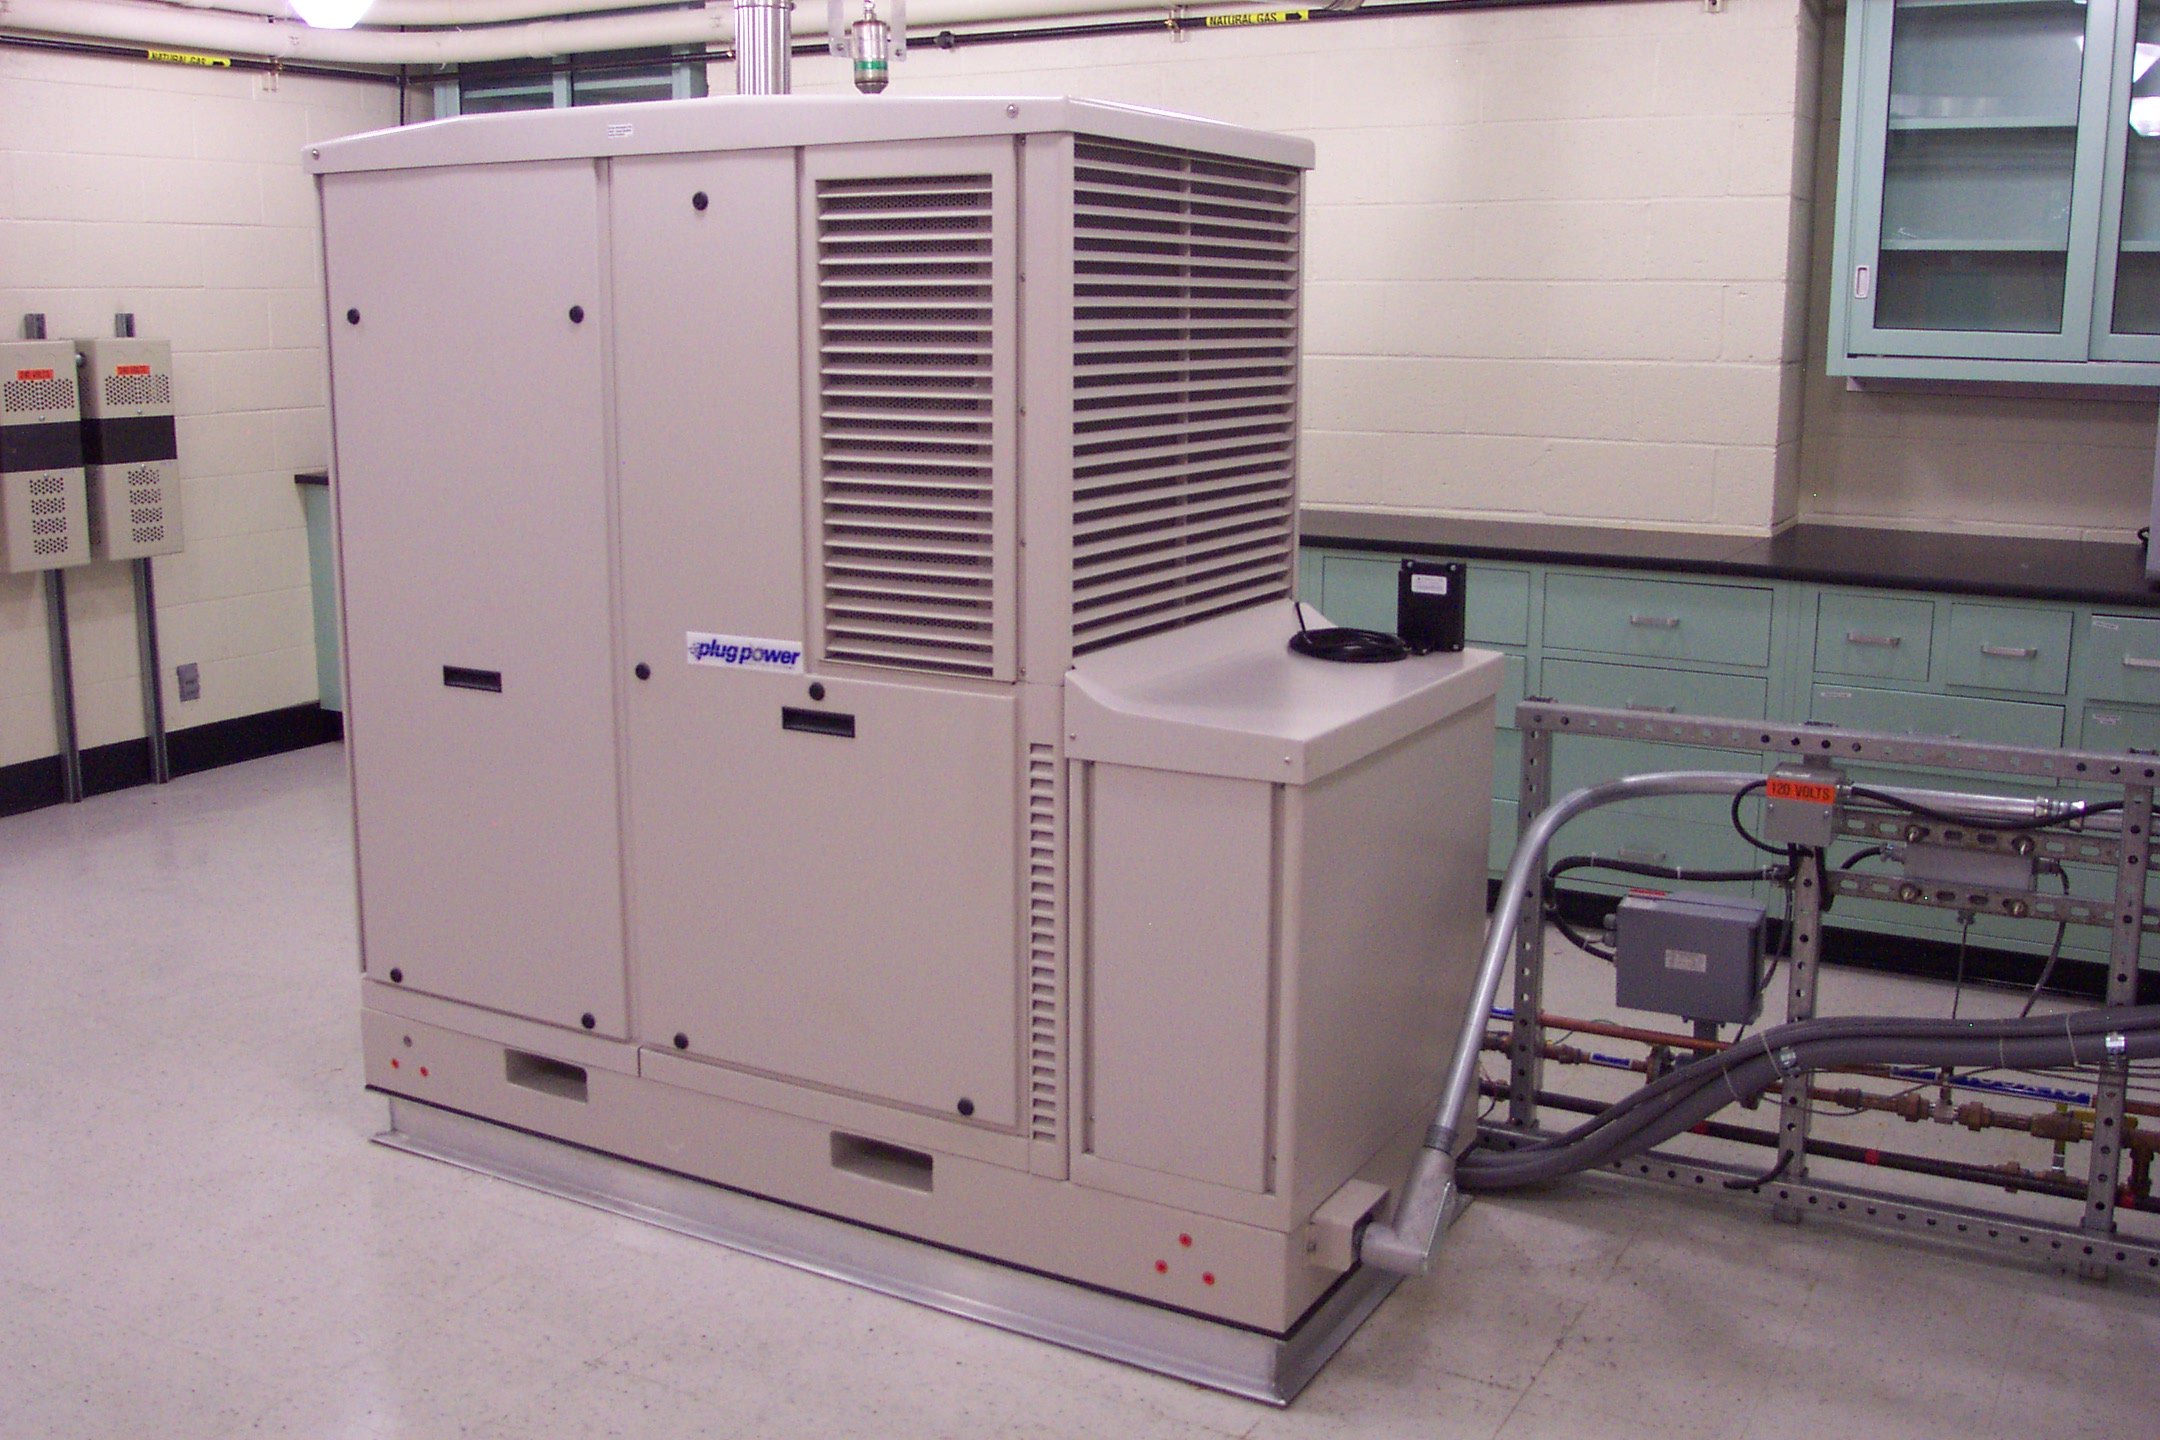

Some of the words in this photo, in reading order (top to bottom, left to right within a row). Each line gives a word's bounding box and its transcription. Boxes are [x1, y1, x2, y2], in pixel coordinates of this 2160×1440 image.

[1210, 14, 1252, 26] NATURAL
[1257, 12, 1277, 22] GAS
[1772, 783, 1790, 796] 120
[1794, 784, 1830, 801] VOLTS
